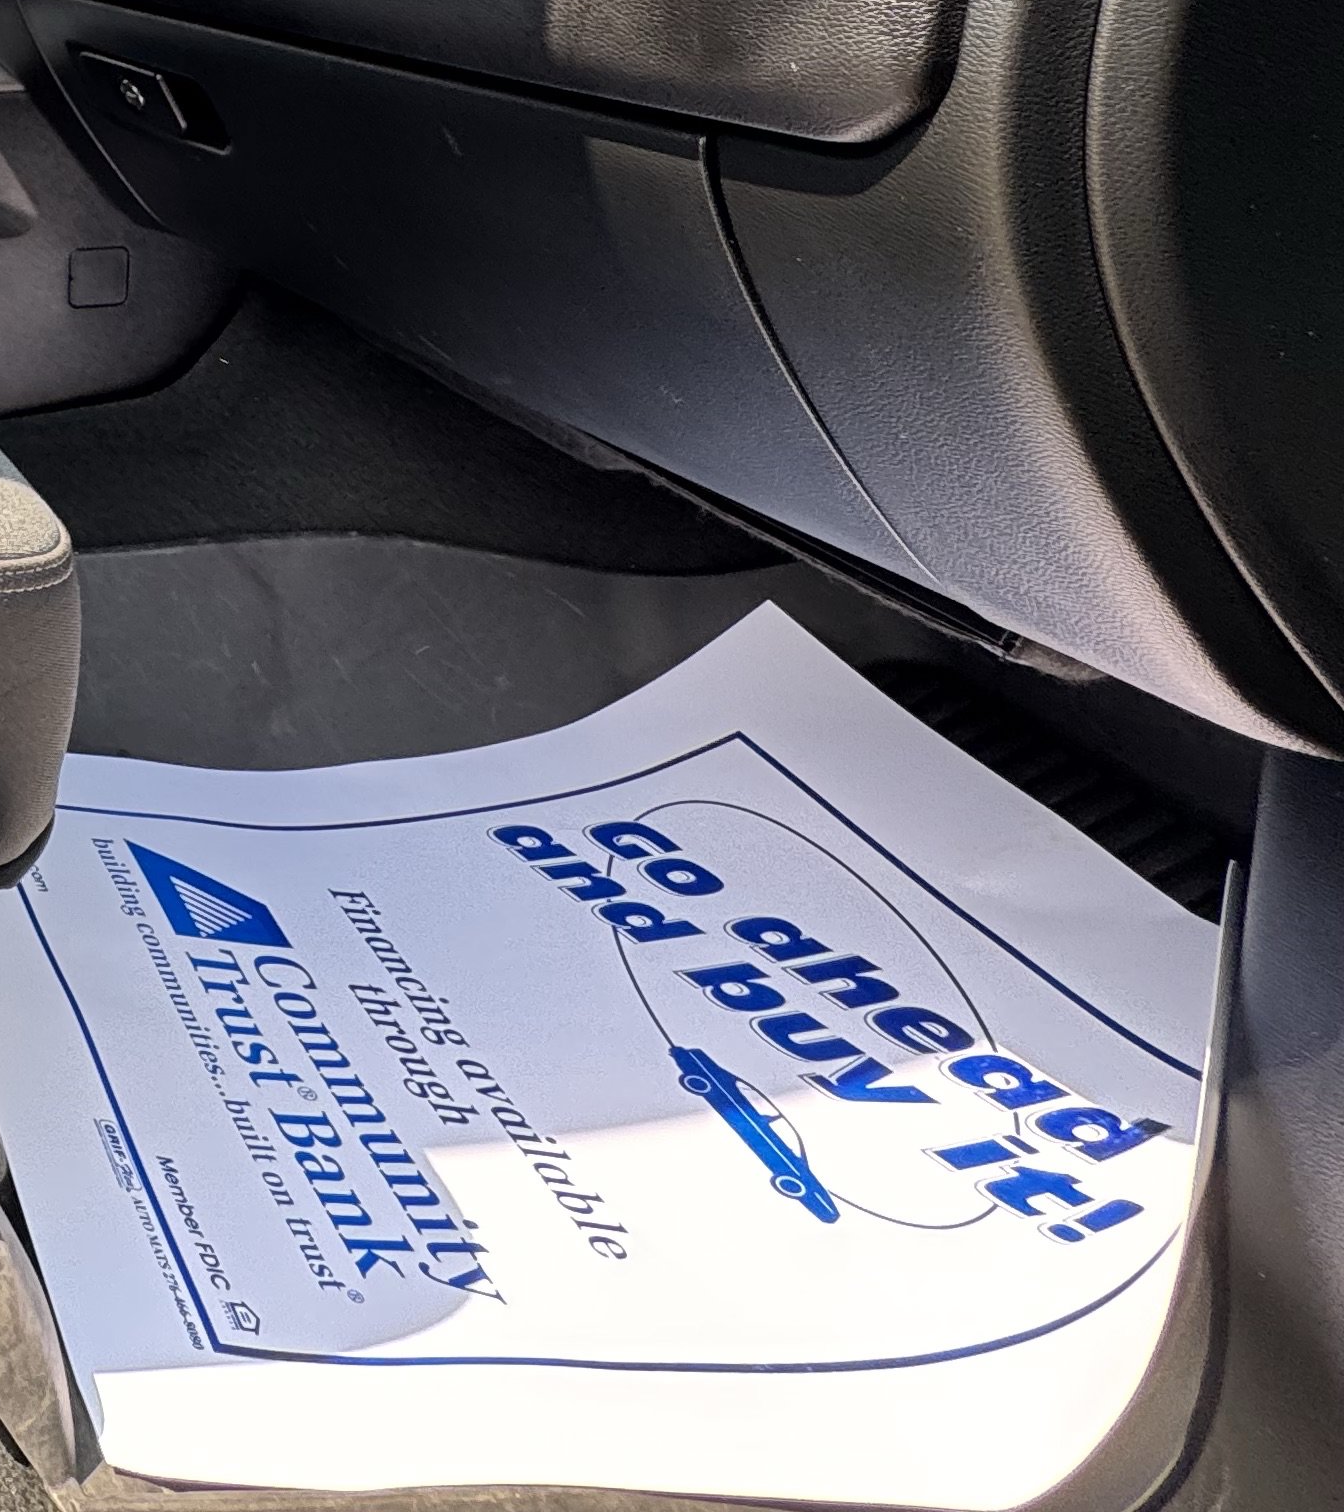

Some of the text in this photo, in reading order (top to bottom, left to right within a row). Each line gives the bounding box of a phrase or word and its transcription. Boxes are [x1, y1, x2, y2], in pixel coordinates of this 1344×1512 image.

[91, 838, 145, 918] building
[262, 1171, 294, 1207] on
[253, 955, 508, 1305] Community
[328, 888, 630, 1260] Financing available
[348, 983, 481, 1126] through
[486, 825, 1145, 1245] and buy it!
[582, 821, 1172, 1165] Go ahead
[132, 1196, 155, 1232] AUTO
[148, 1234, 172, 1275] MATS
[156, 1155, 204, 1238] Member
[194, 1242, 231, 1291] FDIC
[268, 1107, 414, 1279] Bank
